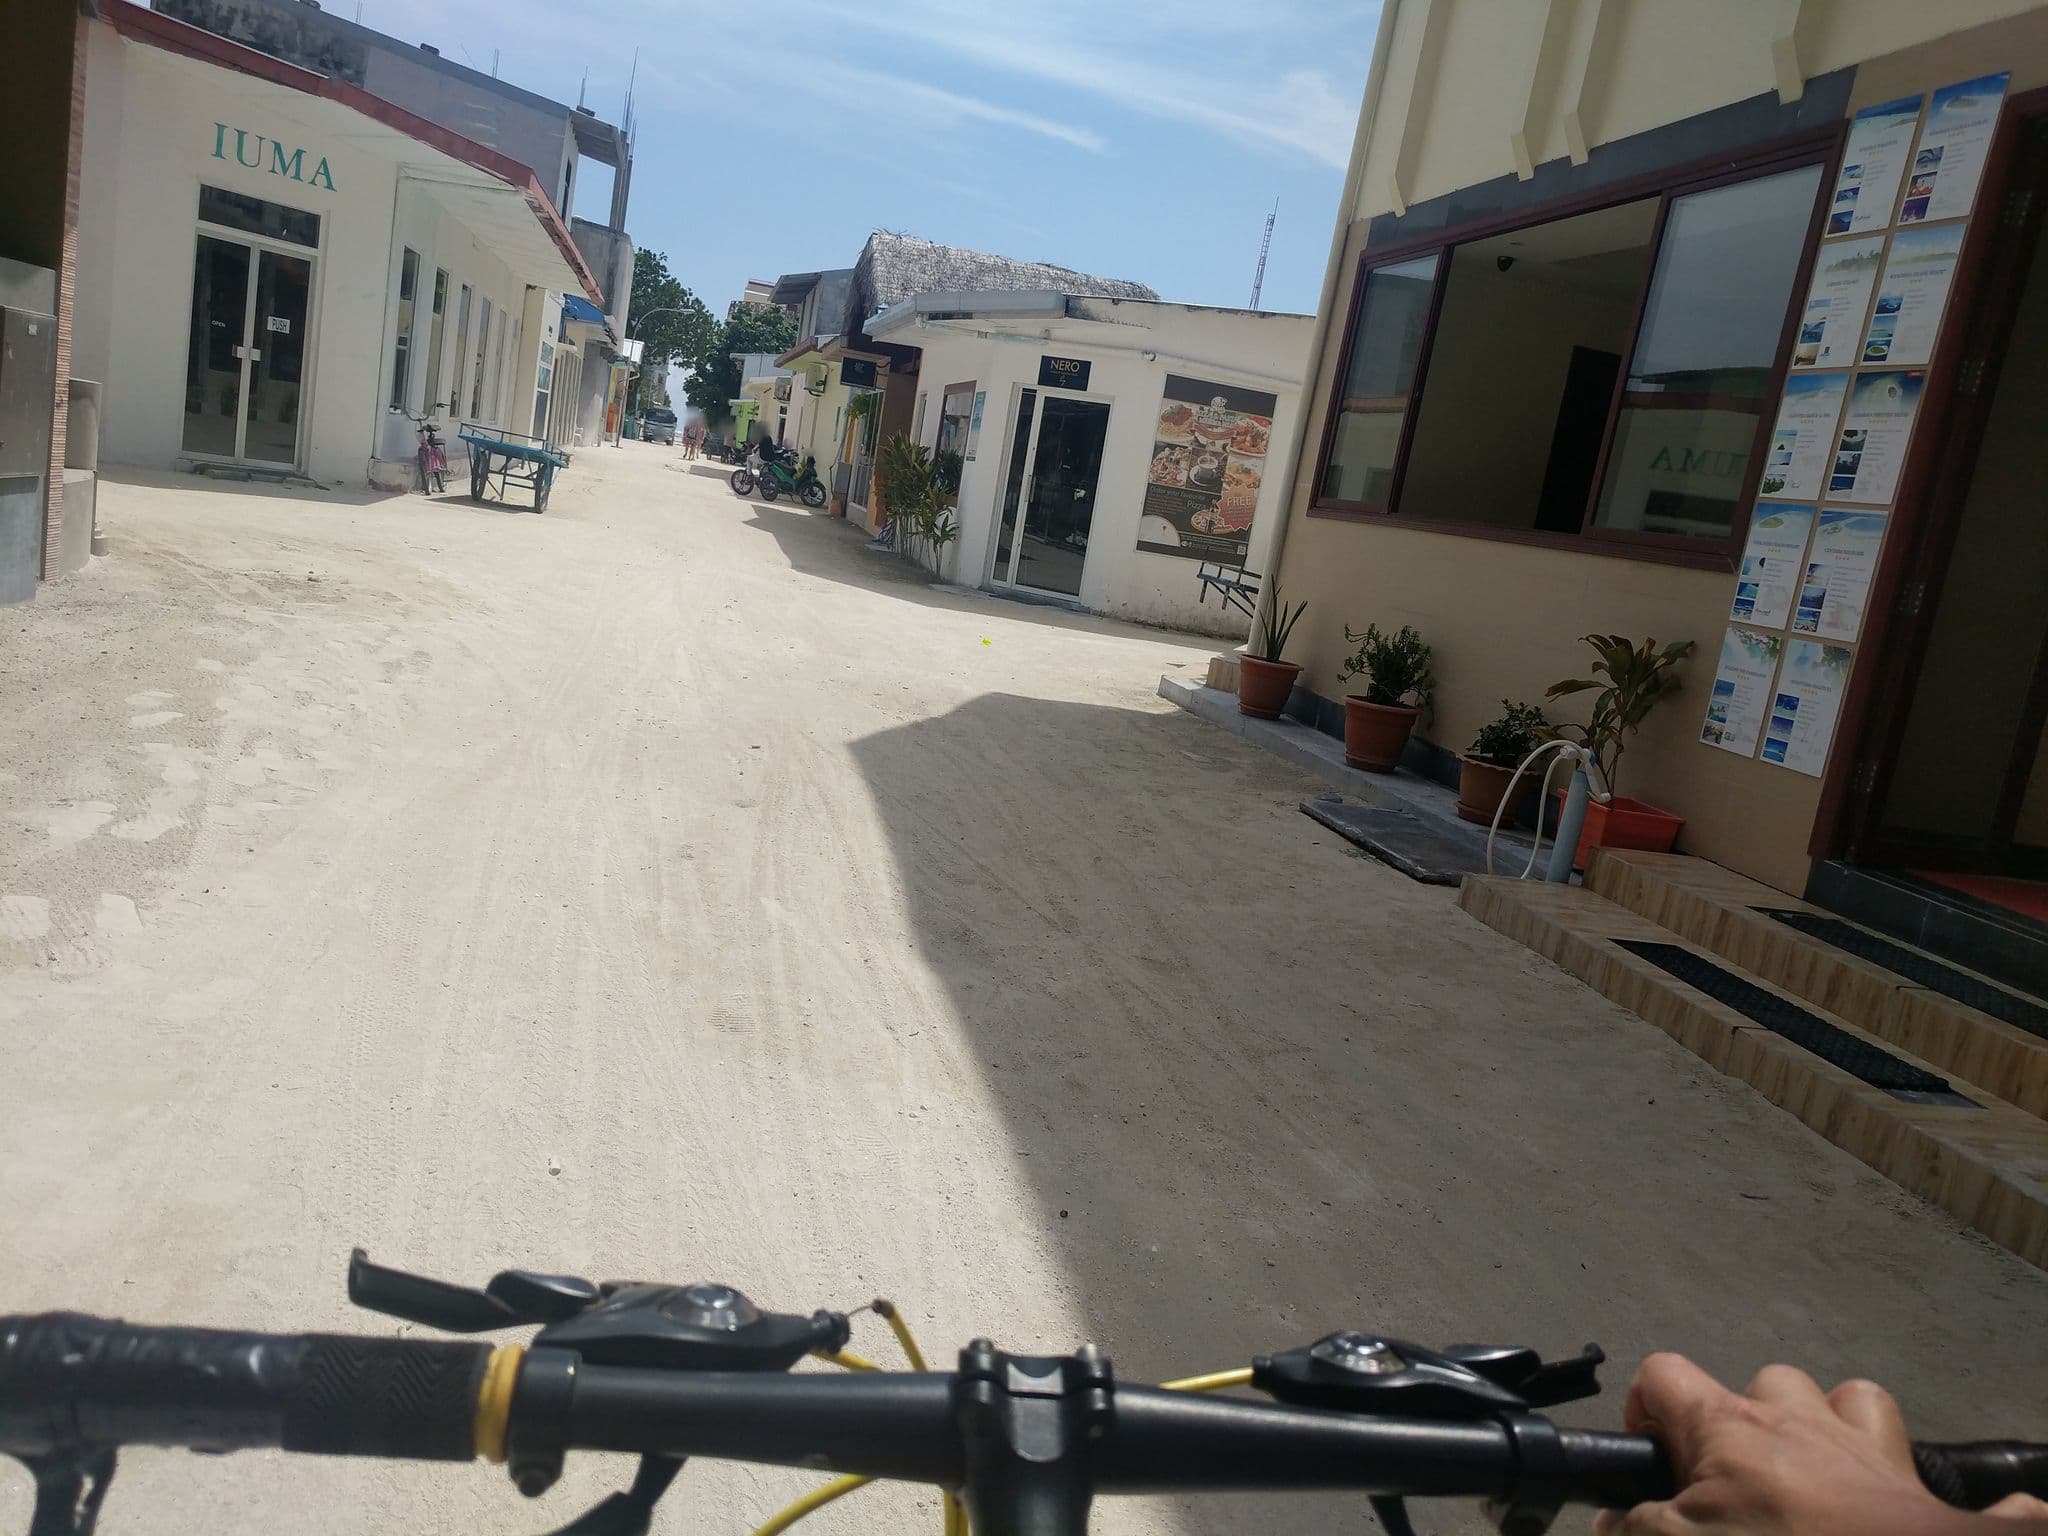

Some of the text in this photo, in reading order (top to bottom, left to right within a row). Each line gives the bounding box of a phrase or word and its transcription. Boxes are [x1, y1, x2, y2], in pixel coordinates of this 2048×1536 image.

[211, 122, 337, 192] IUMA
[211, 320, 226, 328] OPEN
[271, 318, 288, 332] PUSH
[1050, 359, 1080, 373] NERO
[1226, 496, 1252, 506] FREE
